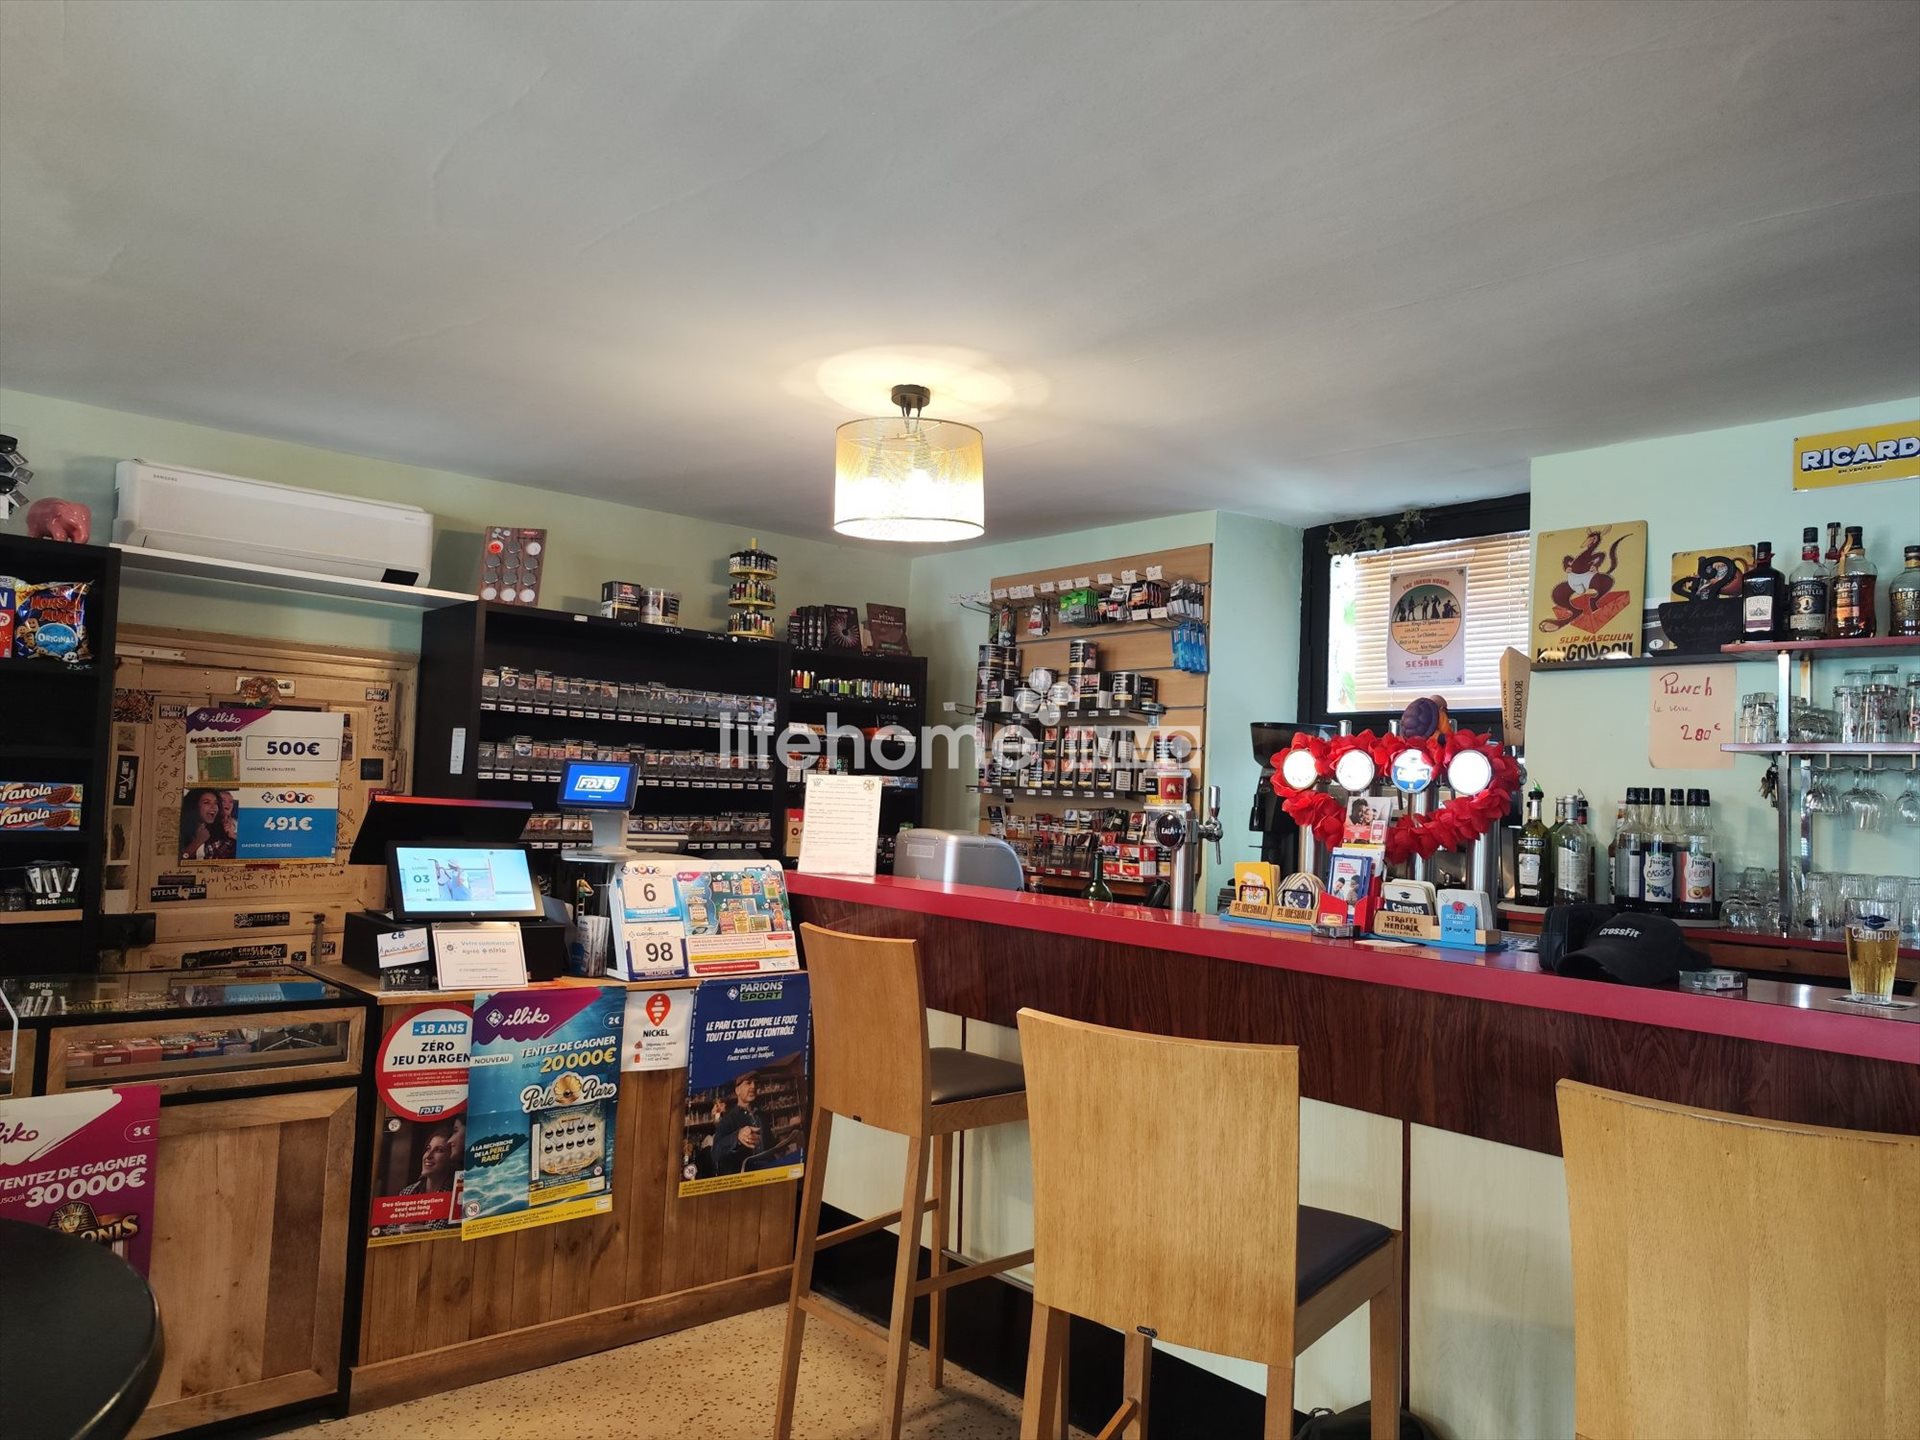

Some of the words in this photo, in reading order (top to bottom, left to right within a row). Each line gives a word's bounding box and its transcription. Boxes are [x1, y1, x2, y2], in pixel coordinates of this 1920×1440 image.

[1801, 437, 1920, 471] RICARD
[1833, 581, 1858, 590] JURA
[37, 633, 76, 643] ORIGINAL
[1560, 636, 1579, 644] SLIP
[1582, 633, 1633, 643] MASCULIN
[1405, 659, 1444, 667] SESAME
[1513, 680, 1523, 730] AVERBODE
[208, 712, 242, 724] illiko
[266, 741, 320, 756] 500€
[580, 778, 602, 789] FDJ
[0, 783, 52, 801] ranola
[276, 791, 315, 803] LOTO
[0, 807, 50, 825] ranola
[264, 816, 313, 831] 491€
[413, 874, 430, 883] 03
[643, 883, 657, 902] 6
[1386, 915, 1418, 925] STRAFFE
[391, 932, 406, 940] CB
[645, 942, 673, 962] 98
[740, 981, 783, 993] PARIONS
[742, 992, 781, 1000] SPORT
[503, 1006, 550, 1026] illiko
[608, 1016, 619, 1024] 2€
[438, 1023, 465, 1033] ANS
[706, 1022, 713, 1031] LE
[714, 1020, 730, 1030] PARI
[730, 1018, 748, 1029] C'EST
[750, 1017, 773, 1028] COMME
[774, 1016, 781, 1025] LE
[706, 1032, 723, 1042] TOUT
[724, 1031, 736, 1040] EST
[736, 1030, 755, 1039] DANS
[756, 1028, 763, 1037] LE
[763, 1025, 795, 1037] CONTRÔLE
[421, 1040, 455, 1052] ZÉRO
[521, 1043, 558, 1058] TENTEZ
[560, 1042, 573, 1052] DE
[576, 1036, 616, 1050] GAGNER
[392, 1055, 414, 1066] JEU
[418, 1053, 471, 1065] D'ARGEN
[474, 1055, 510, 1064] NOUVEAU
[582, 1078, 615, 1099] Rare
[524, 1088, 554, 1110] Perle
[133, 1126, 151, 1137] 3€
[489, 1145, 510, 1156] PERLE
[481, 1154, 500, 1164] RARE
[58, 1166, 78, 1181] DE
[81, 1154, 147, 1176] GAGNER
